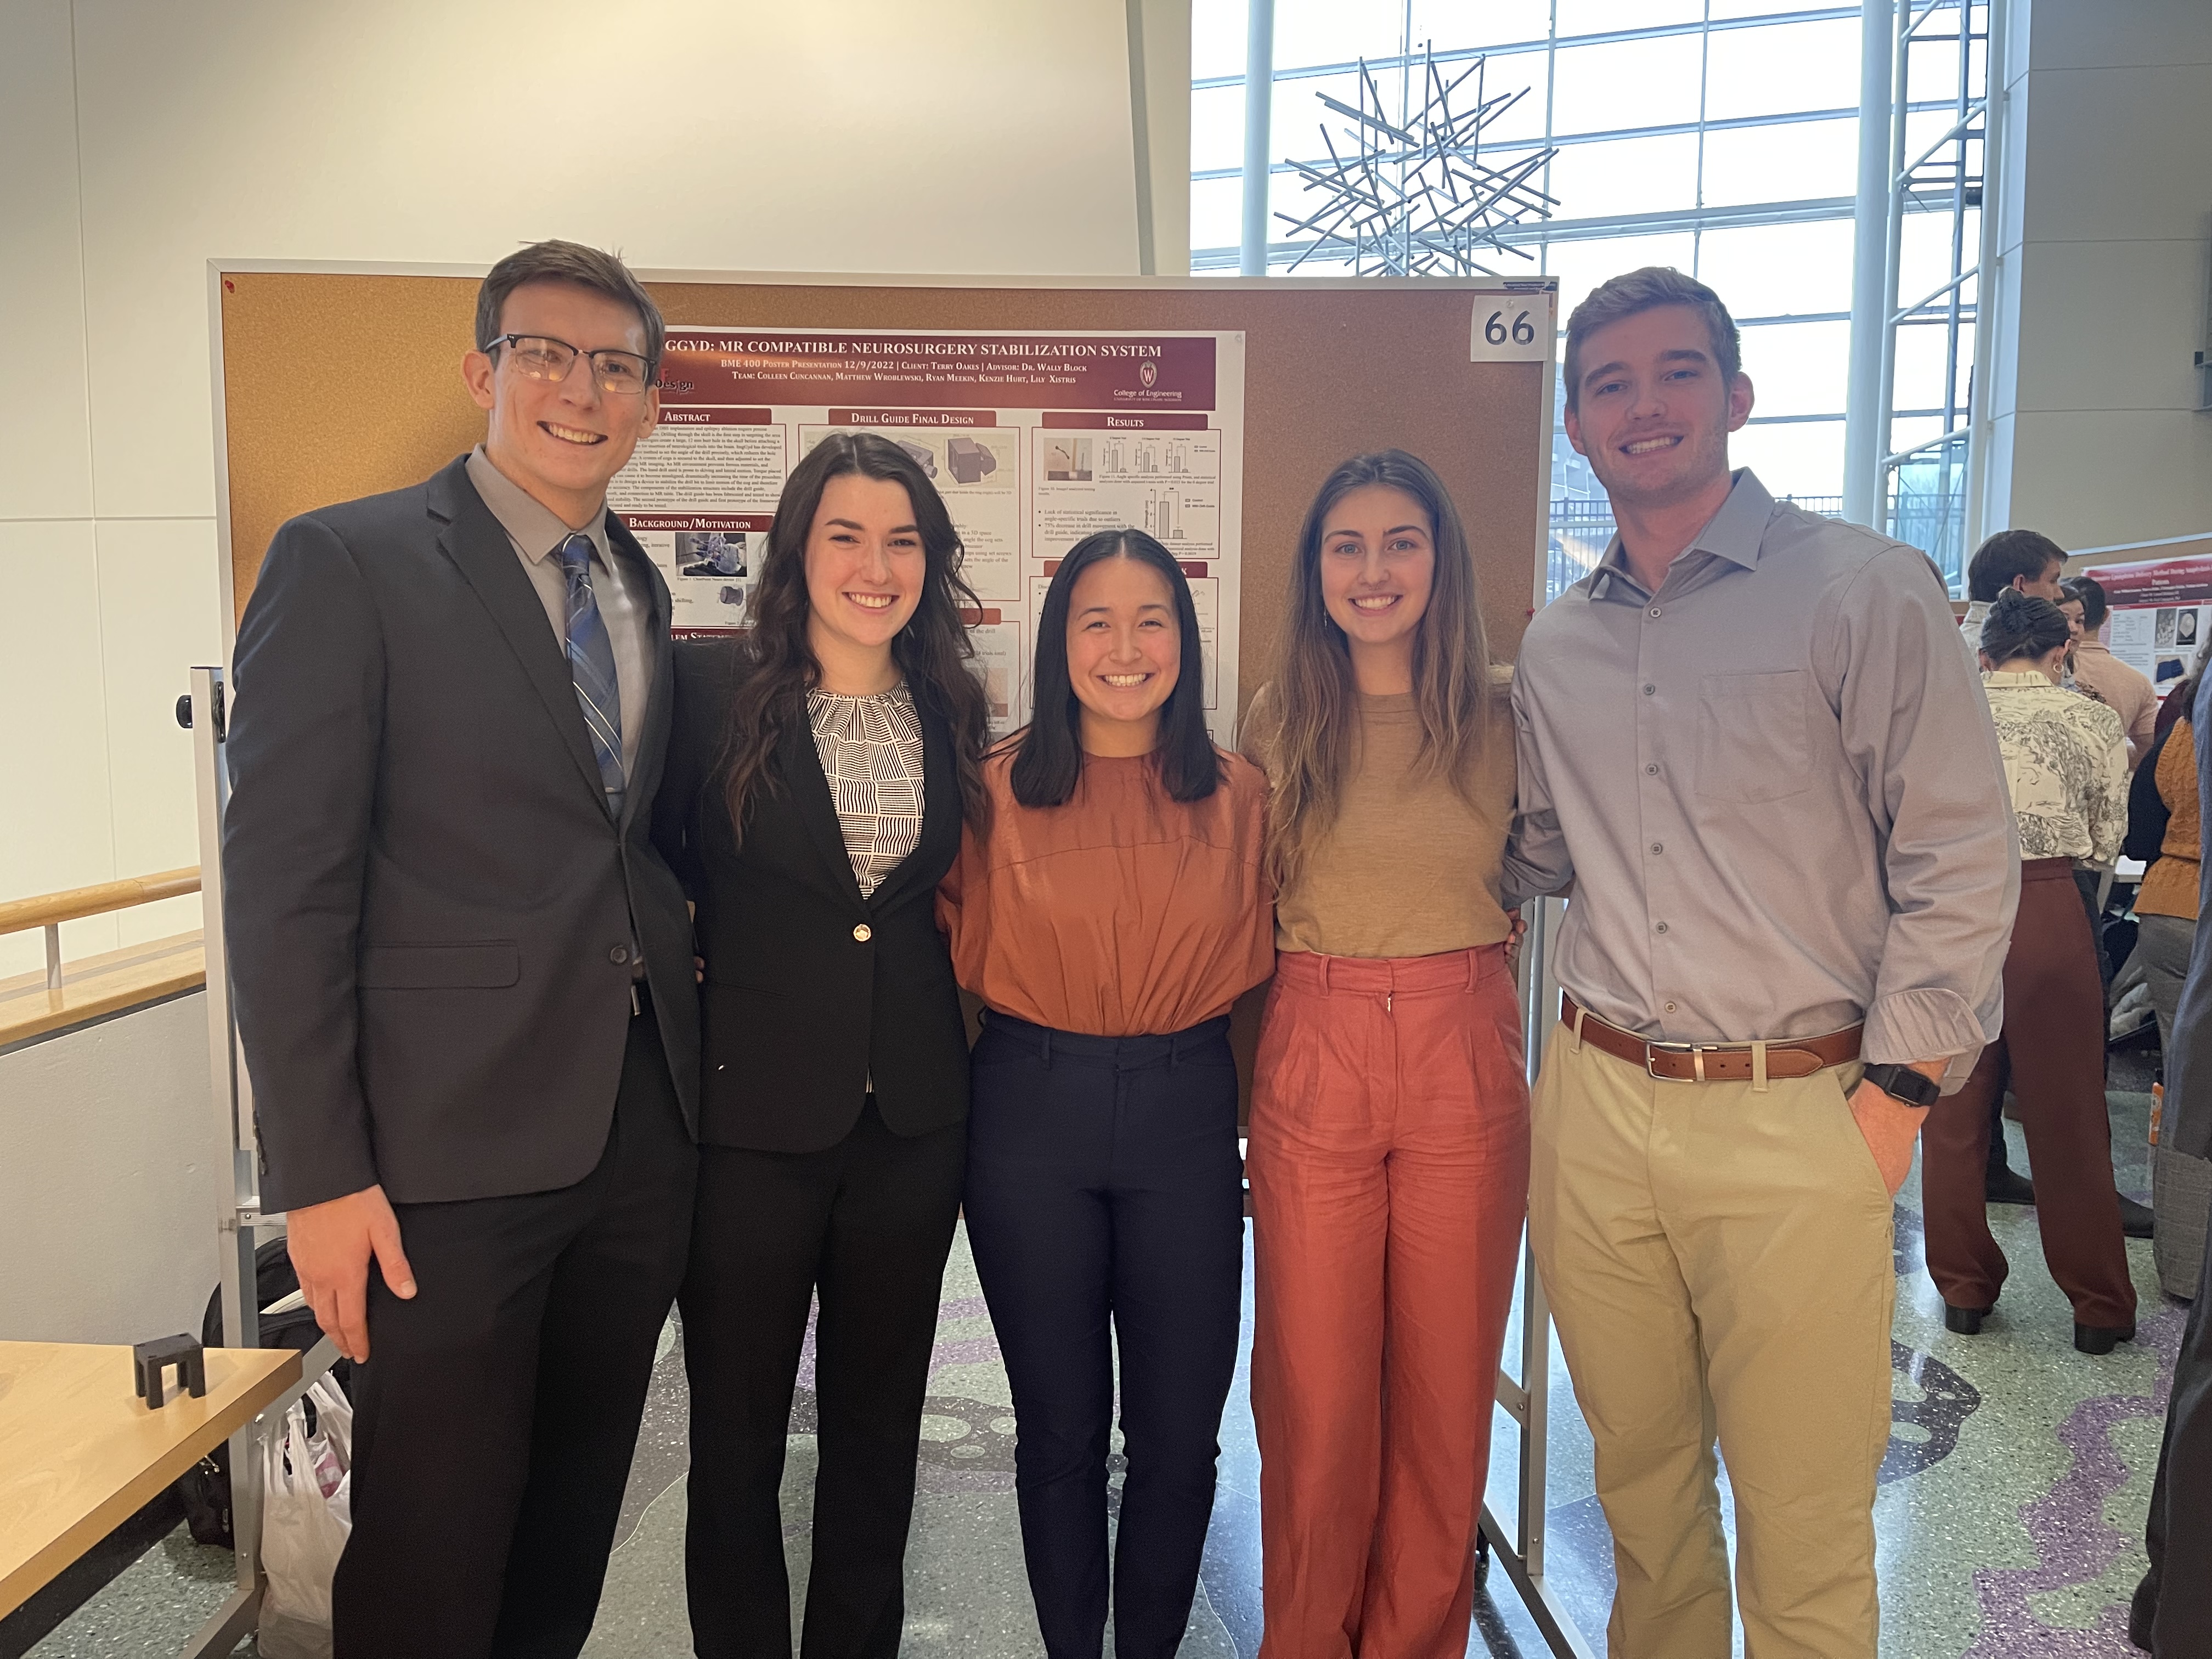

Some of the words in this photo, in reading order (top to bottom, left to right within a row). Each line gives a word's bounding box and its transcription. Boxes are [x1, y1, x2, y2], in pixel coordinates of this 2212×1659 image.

[1485, 310, 1534, 346] 66
[719, 341, 743, 352] MR
[748, 341, 847, 353] COMPATIBLE
[852, 342, 978, 355] NEUROSURGERY
[981, 344, 1097, 356] STABILIZATION
[1101, 345, 1161, 357] SYSTEM
[721, 359, 741, 368] BME
[844, 360, 894, 371] 12/9/2022
[1114, 389, 1137, 397] College
[1146, 390, 1182, 398] Engineering
